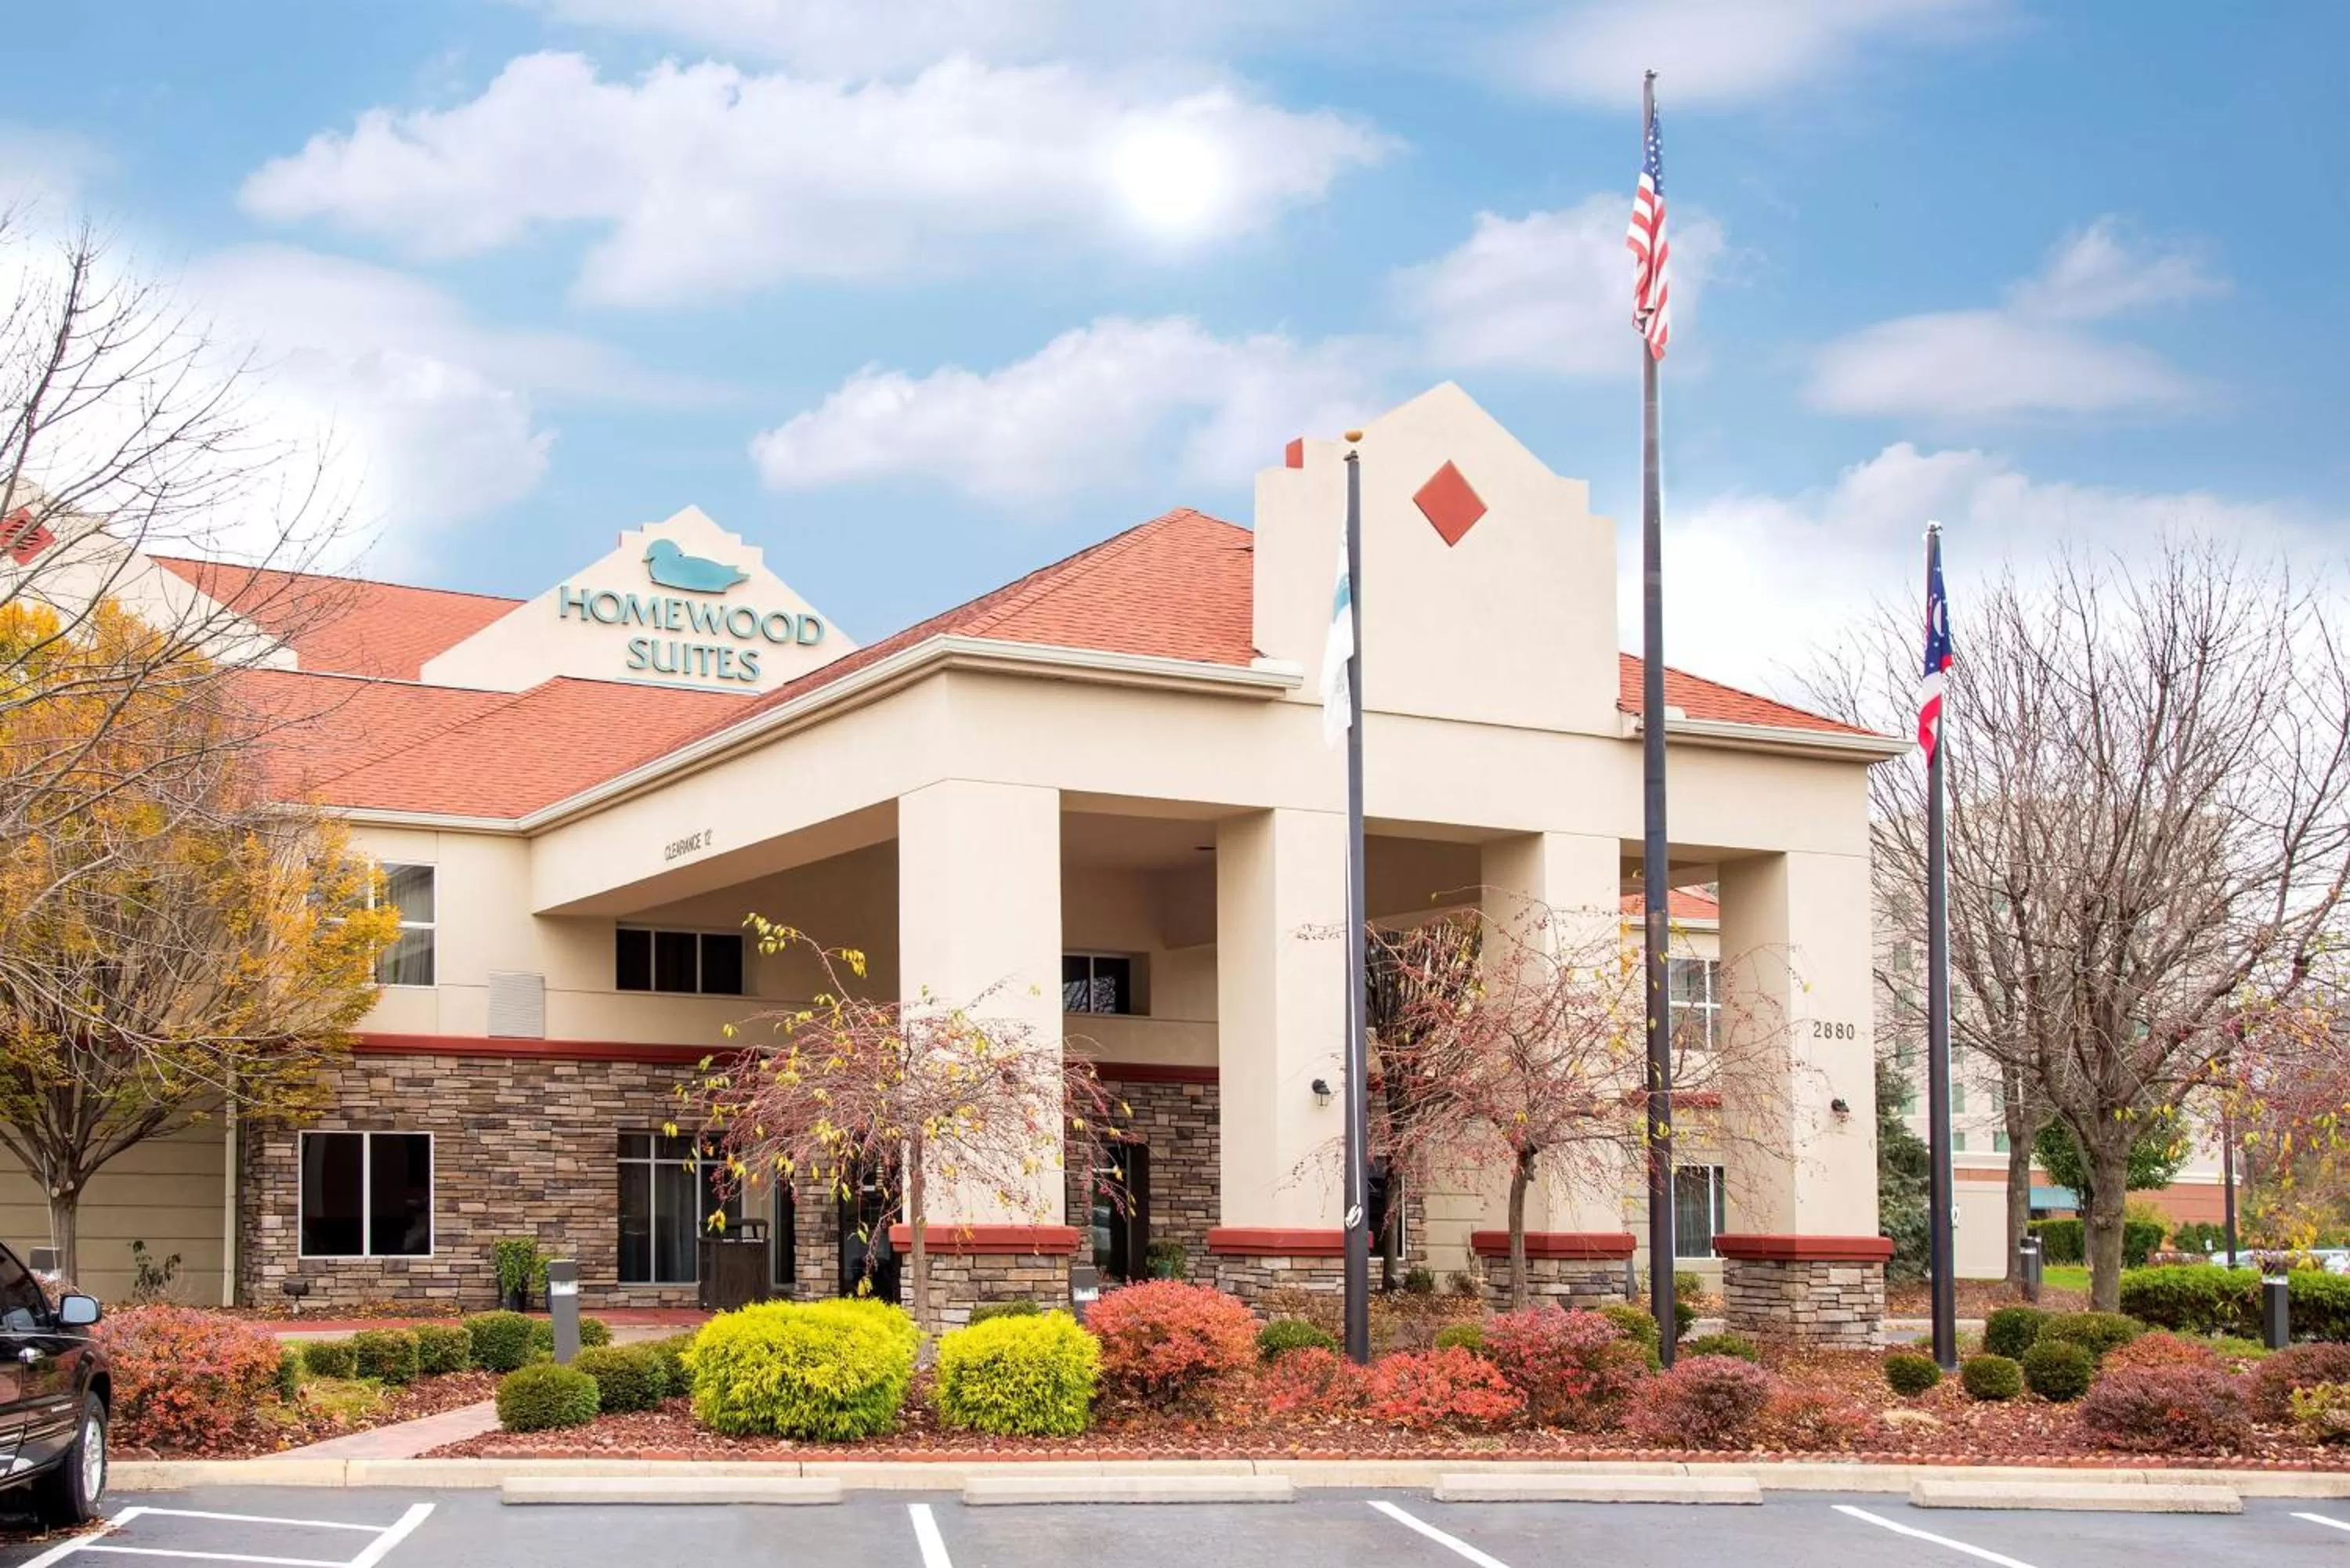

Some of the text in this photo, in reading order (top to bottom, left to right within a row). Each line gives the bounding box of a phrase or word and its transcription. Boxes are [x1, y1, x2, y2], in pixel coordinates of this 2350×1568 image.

[559, 585, 825, 645] HOMEWOOD
[627, 637, 761, 681] SUITES
[1813, 1021, 1854, 1039] 2880
